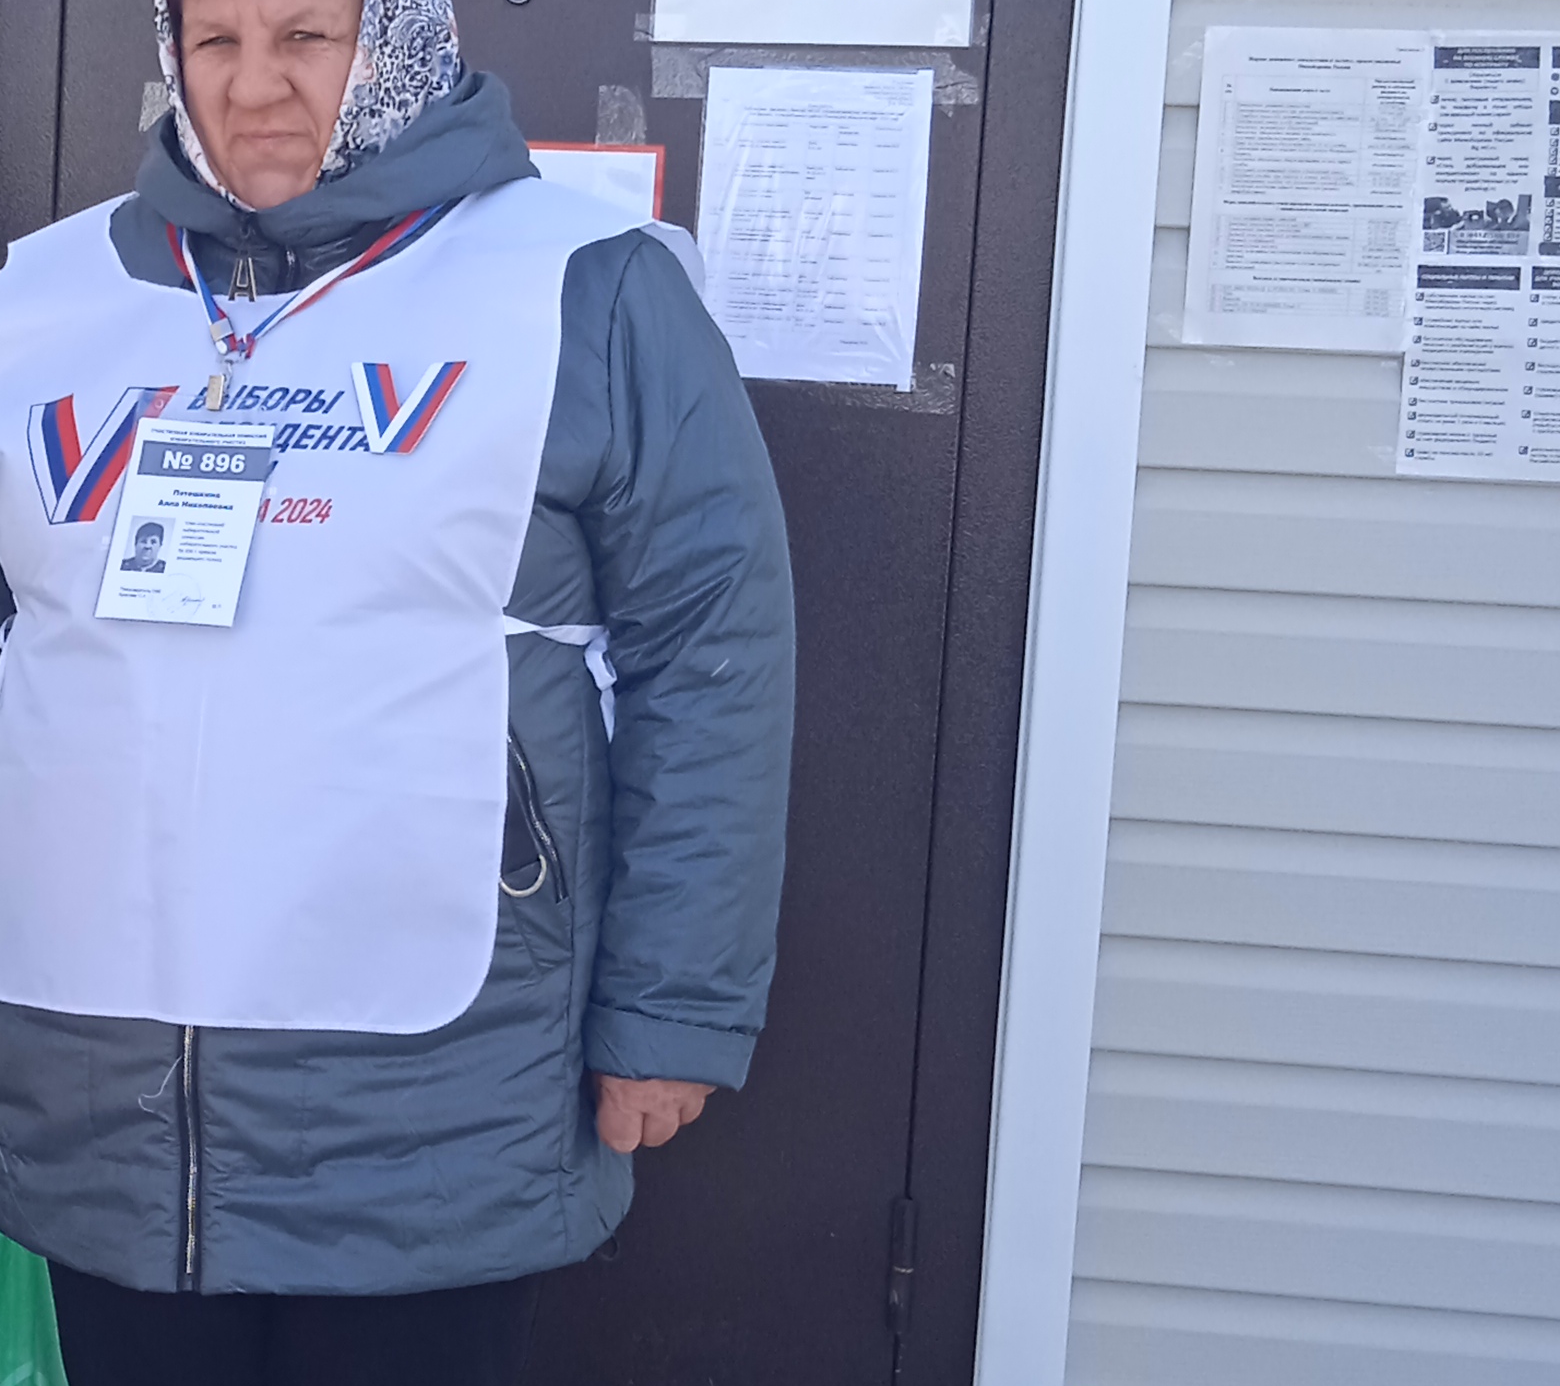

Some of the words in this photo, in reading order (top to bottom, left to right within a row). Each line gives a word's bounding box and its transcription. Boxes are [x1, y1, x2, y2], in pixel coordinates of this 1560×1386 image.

[162, 449, 194, 471] №
[200, 452, 246, 474] 896
[270, 497, 333, 525] 2024
